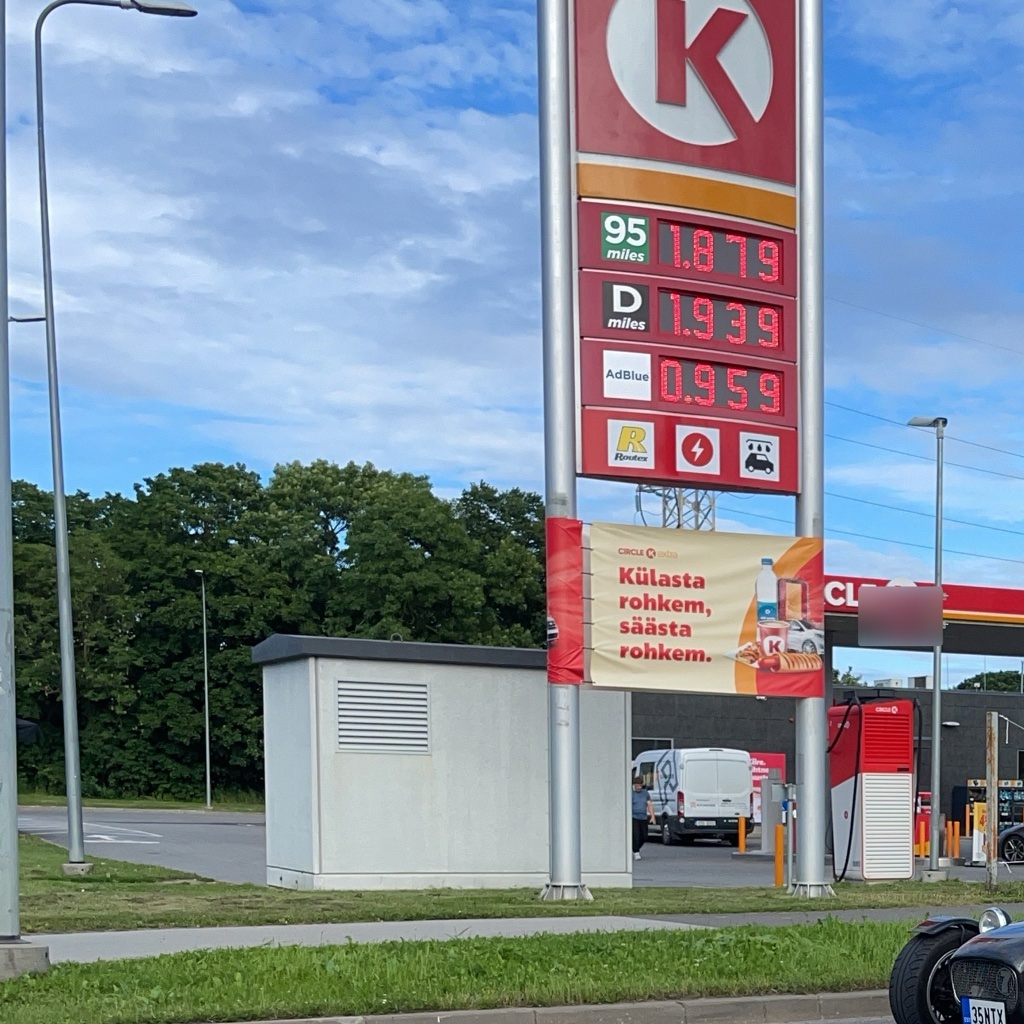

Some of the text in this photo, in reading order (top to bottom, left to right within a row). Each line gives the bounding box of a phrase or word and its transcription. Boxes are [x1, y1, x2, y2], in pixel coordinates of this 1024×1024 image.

[656, 0, 757, 141] K
[603, 215, 647, 246] 95
[606, 248, 645, 262] miles
[670, 224, 779, 282] 1.879
[612, 284, 642, 313] D
[607, 317, 646, 330] miles
[670, 292, 779, 348] 1.939
[605, 369, 650, 382] AdBlue
[660, 359, 780, 414] 0.959
[614, 452, 648, 462] Routex
[618, 548, 644, 556] CIRCLE
[646, 548, 656, 559] K
[619, 566, 705, 589] Külasta
[619, 593, 712, 617] rohkem,
[620, 616, 691, 637] säästa
[620, 642, 712, 662] rohkem.
